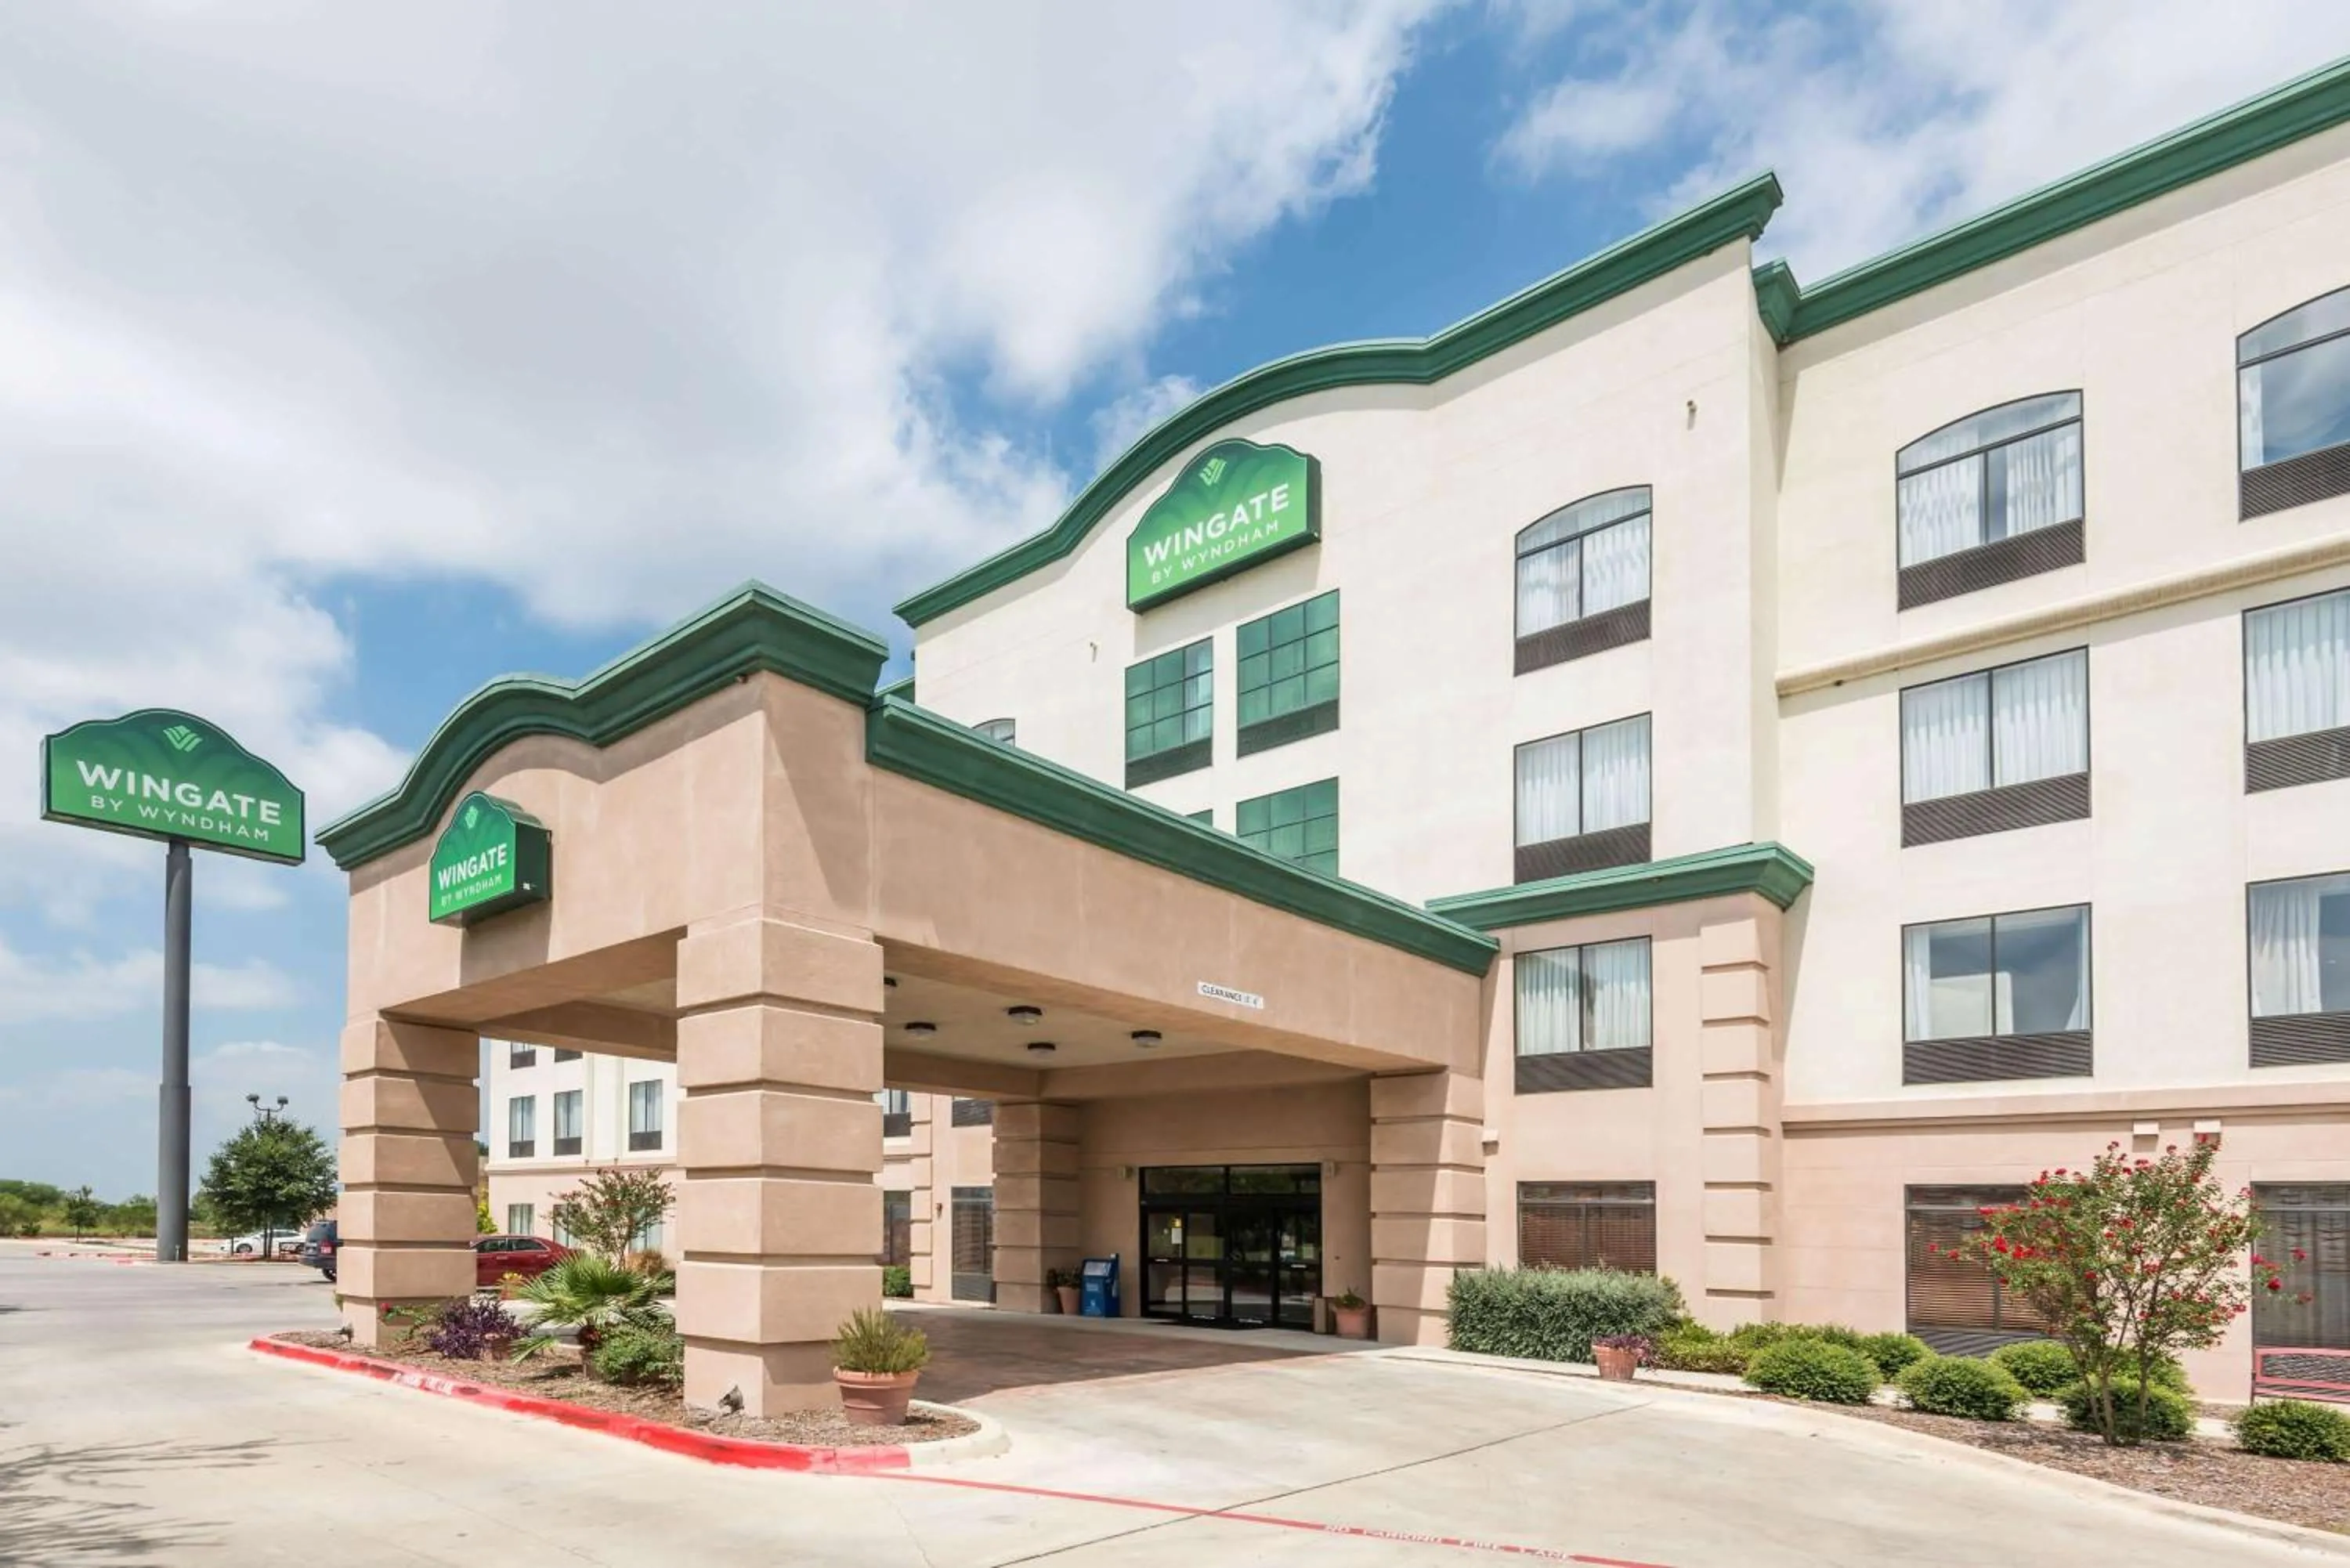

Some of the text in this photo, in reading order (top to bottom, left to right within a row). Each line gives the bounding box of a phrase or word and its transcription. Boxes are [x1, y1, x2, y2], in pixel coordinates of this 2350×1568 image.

[1144, 482, 1289, 566] WINGATE
[1152, 519, 1278, 585] BY WYNDHAM
[76, 760, 282, 826] WINGATE
[91, 795, 269, 842] BY WYNDHAM
[438, 844, 507, 890] WINGATE
[455, 875, 501, 899] WYNDHAM
